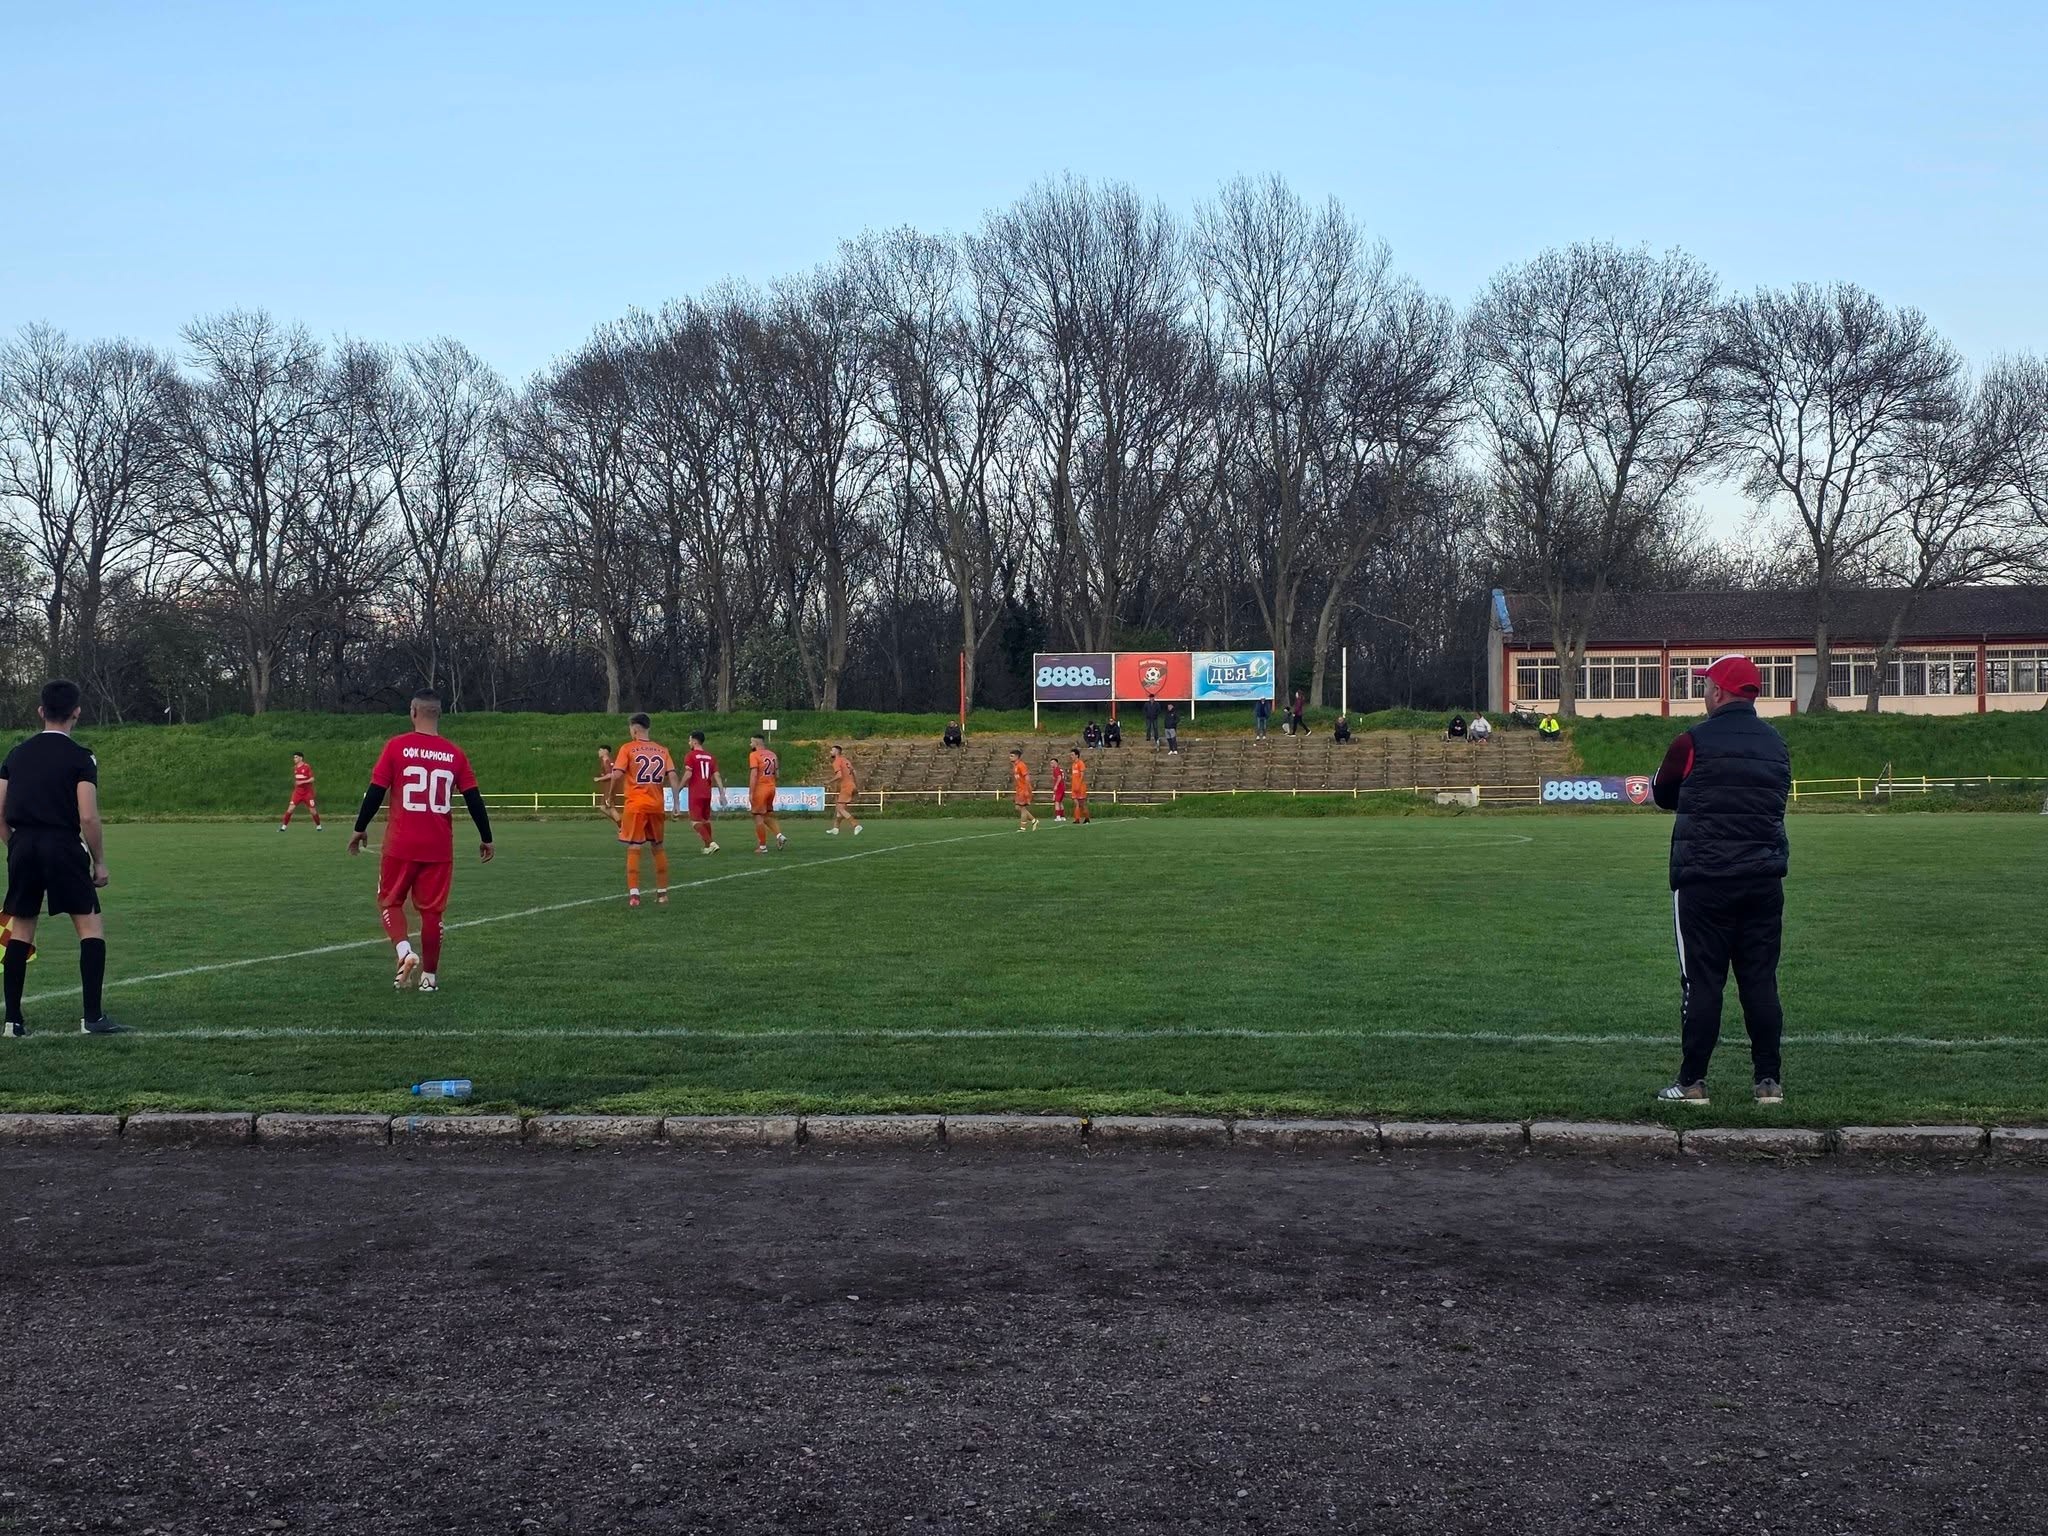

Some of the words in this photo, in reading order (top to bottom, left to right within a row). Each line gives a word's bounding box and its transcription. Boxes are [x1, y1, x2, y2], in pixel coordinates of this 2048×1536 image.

[1210, 668, 1247, 684] ДЕЯ
[403, 747, 419, 759] ОФК
[635, 754, 664, 784] 22
[700, 761, 709, 779] 11
[402, 765, 454, 814] 20
